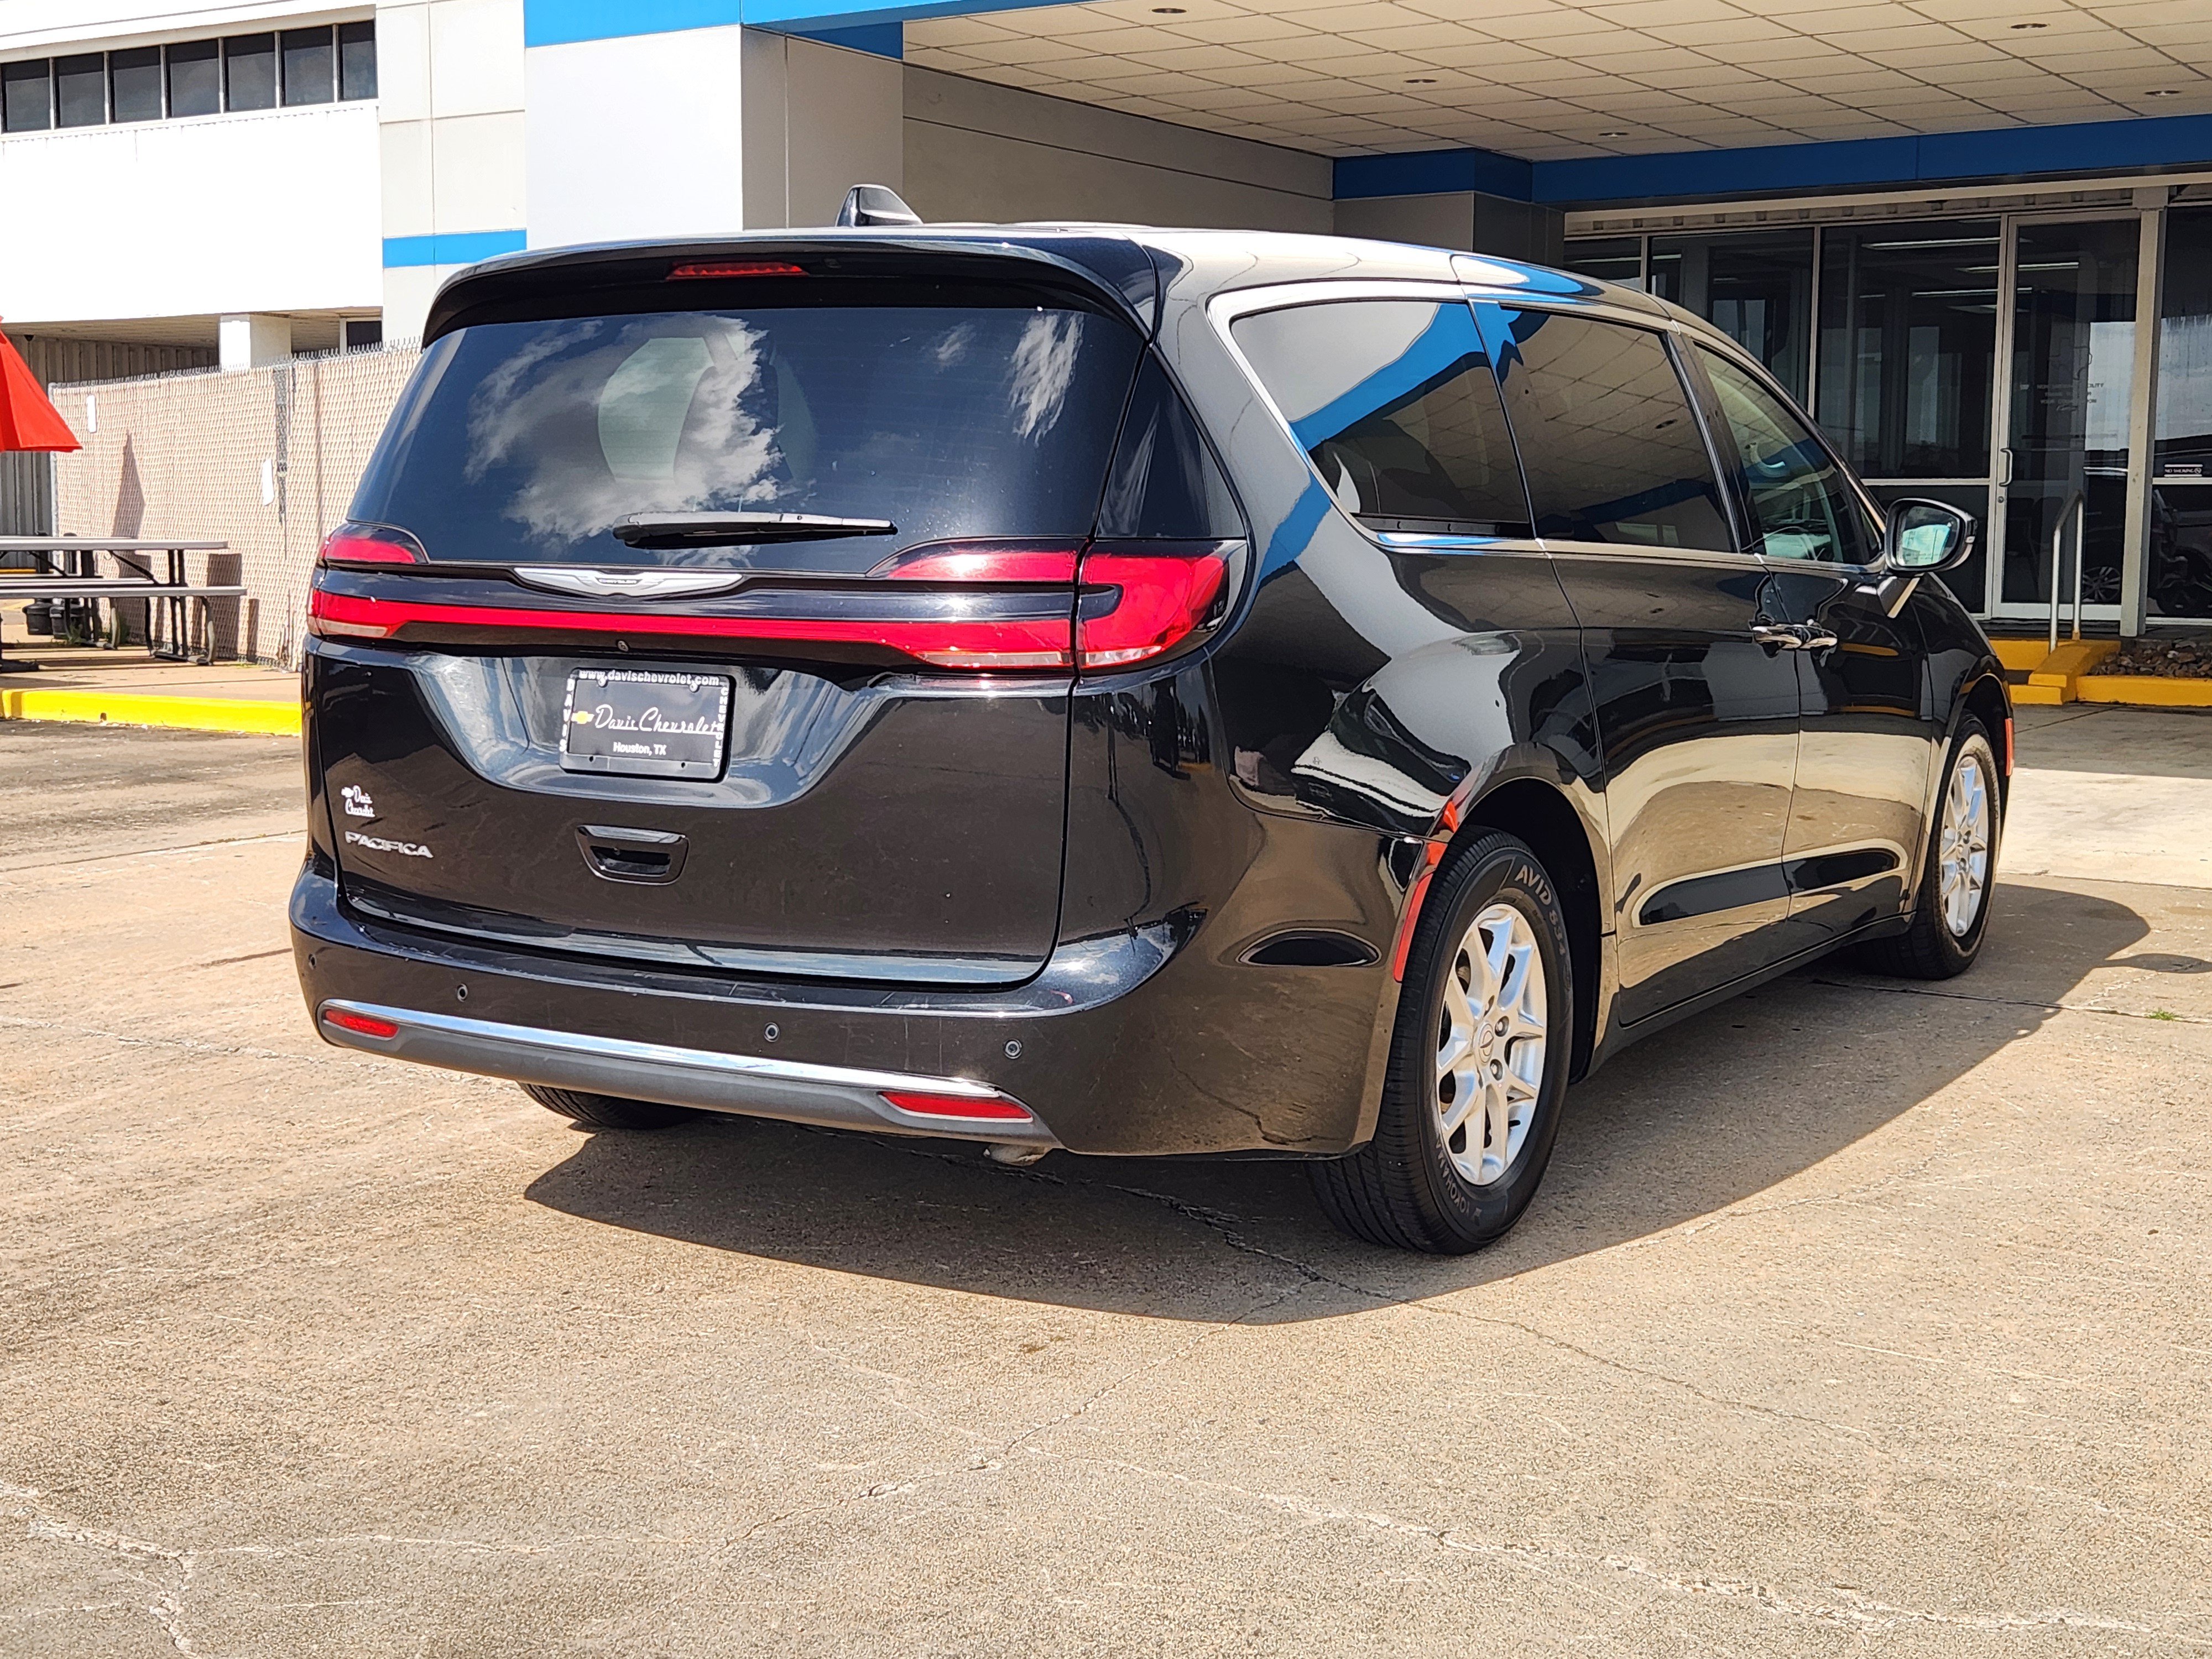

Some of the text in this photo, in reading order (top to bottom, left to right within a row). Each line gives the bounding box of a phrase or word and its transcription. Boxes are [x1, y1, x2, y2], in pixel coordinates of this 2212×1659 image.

[578, 669, 720, 686] www.davischevrolet.com
[559, 678, 575, 753] DAVIS
[594, 703, 721, 735] Davis Chevrolet
[713, 686, 729, 768] CHEVROLET
[613, 741, 667, 757] Houston, TX
[345, 830, 434, 859] PACIFICA
[1514, 864, 1552, 906] AVID
